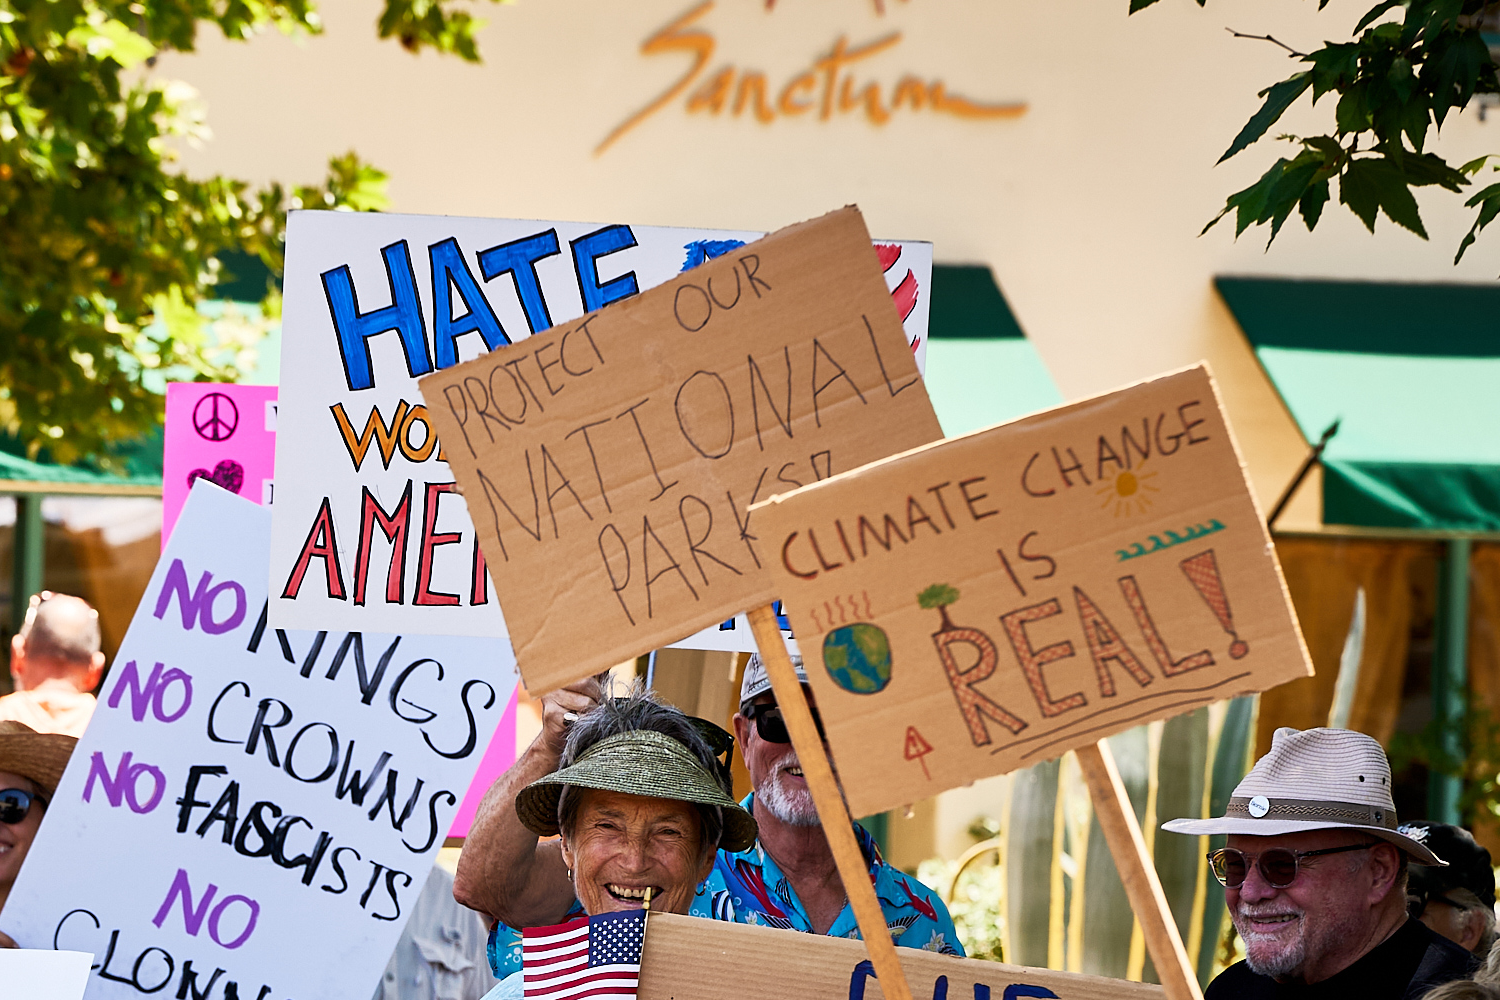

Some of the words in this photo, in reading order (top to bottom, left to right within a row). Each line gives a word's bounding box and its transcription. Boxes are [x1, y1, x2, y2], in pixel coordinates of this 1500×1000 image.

[593, 0, 1028, 158] Sanctum
[320, 224, 639, 391] HATE
[443, 315, 605, 459] PROTECT
[674, 254, 771, 332] OUR
[329, 399, 446, 472] WO
[475, 314, 920, 562] NATIONAL
[781, 477, 1000, 581] CLIMATE
[1021, 401, 1210, 497] CHANGE
[153, 558, 246, 635] NO
[997, 531, 1057, 596] IS
[932, 549, 1250, 747] REAL!
[82, 751, 166, 814] NO
[175, 765, 413, 921] FASCISTS
[107, 659, 193, 723] NO
[206, 681, 456, 854] CROWNS
[152, 868, 260, 949] NO
